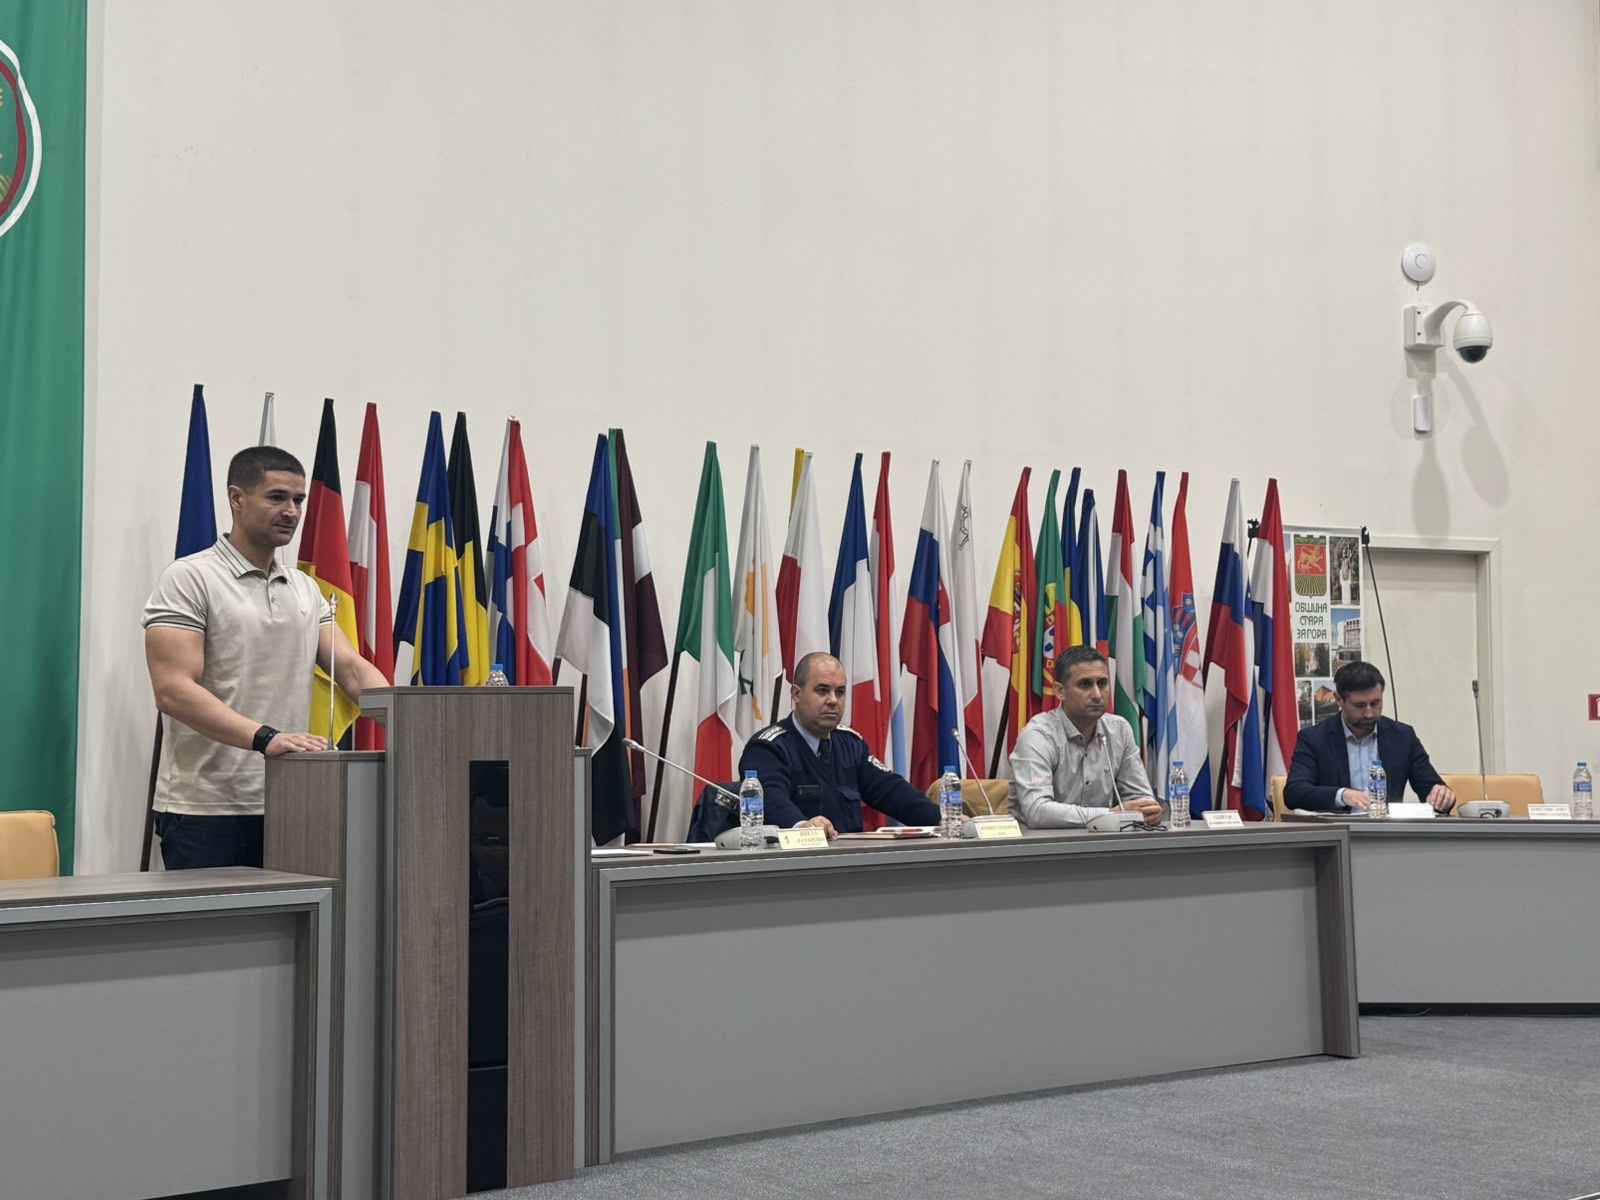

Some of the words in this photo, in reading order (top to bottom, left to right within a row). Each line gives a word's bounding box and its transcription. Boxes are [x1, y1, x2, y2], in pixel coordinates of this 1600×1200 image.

[1295, 602, 1327, 613] ОБЩИНА
[1300, 616, 1323, 625] СТАРА
[1296, 628, 1327, 639] ЗАГОРА
